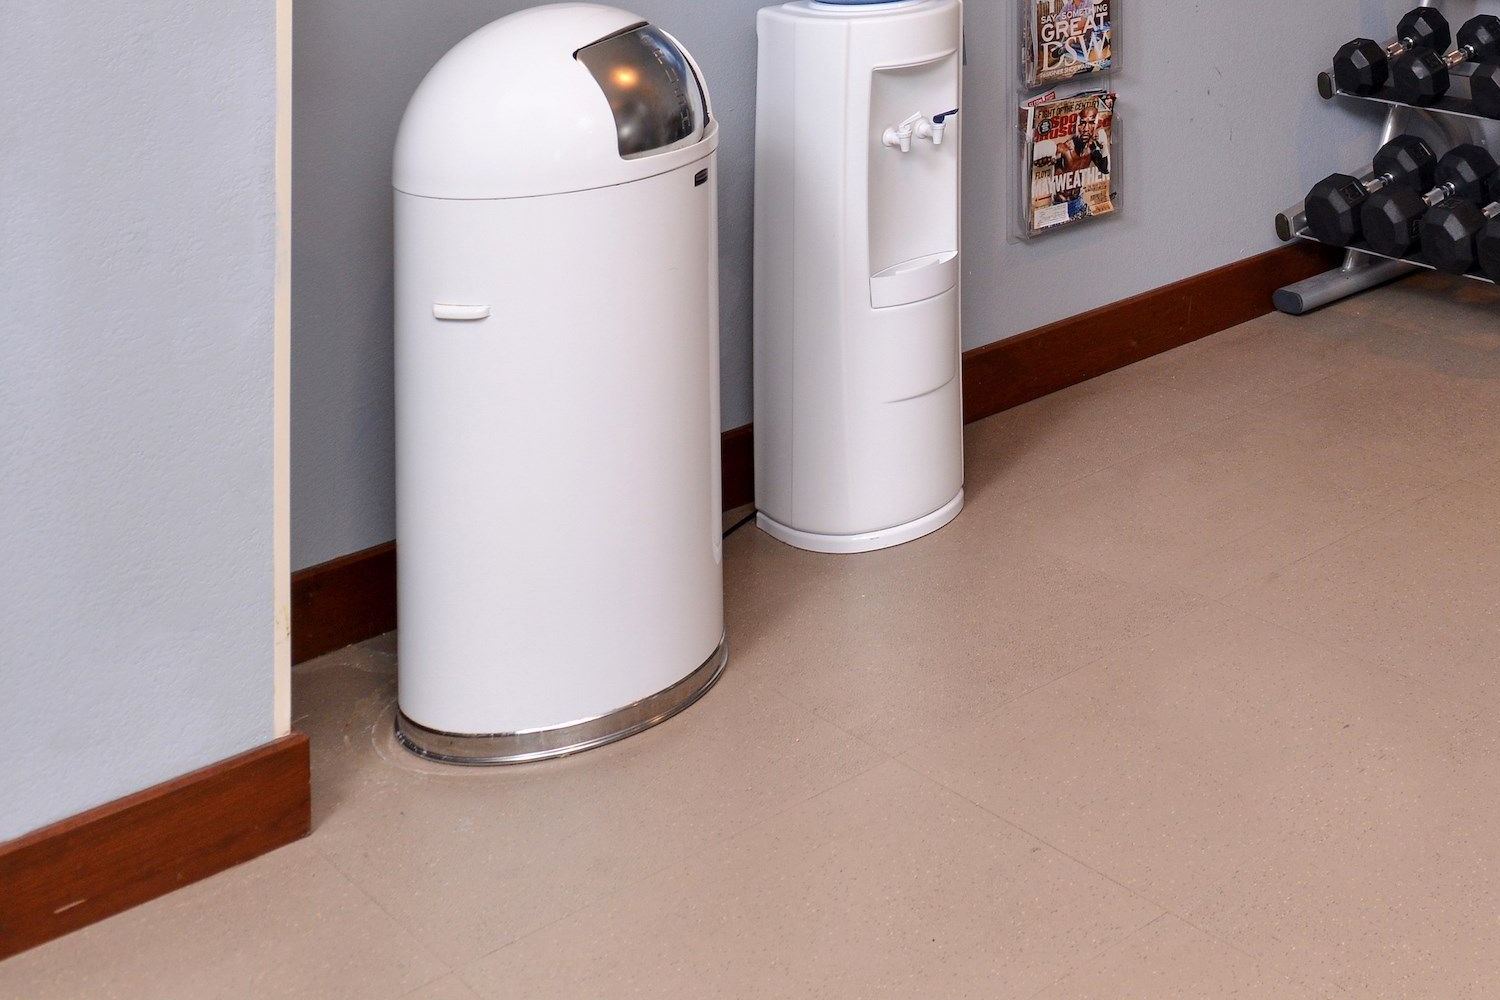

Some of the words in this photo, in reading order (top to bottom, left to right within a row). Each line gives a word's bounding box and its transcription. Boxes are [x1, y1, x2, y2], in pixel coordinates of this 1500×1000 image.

[1041, 14, 1057, 24] SAY
[1062, 4, 1108, 20] SOMETHING
[1041, 12, 1108, 42] GREAT
[1041, 32, 1111, 72] DSW
[1038, 108, 1055, 118] FIGHT
